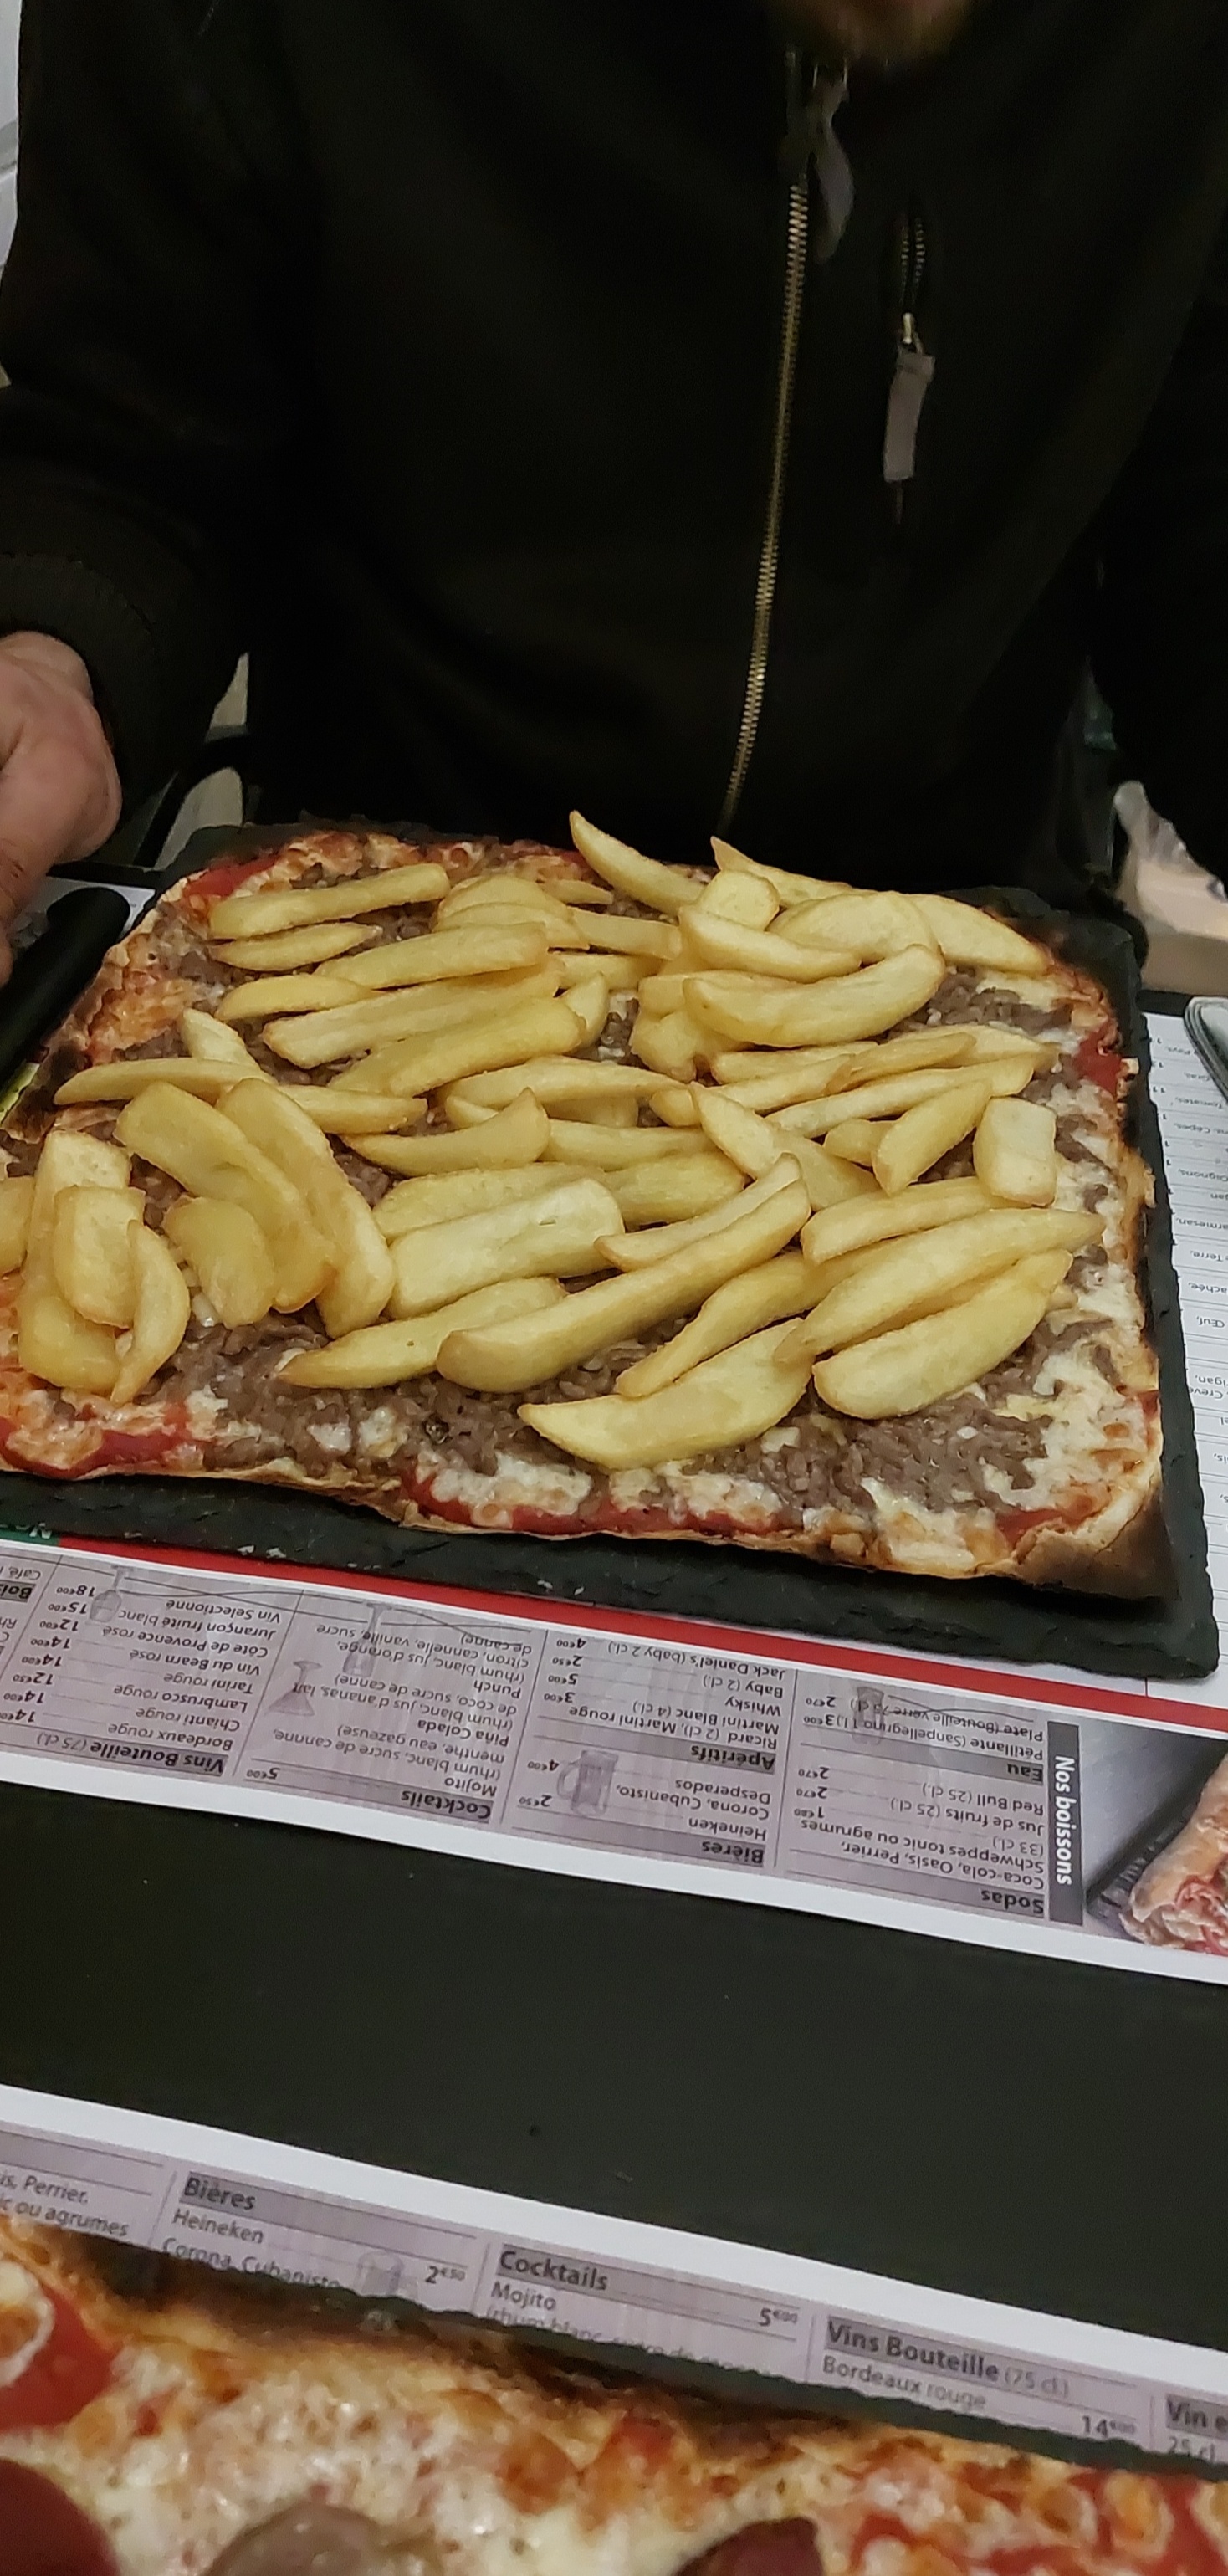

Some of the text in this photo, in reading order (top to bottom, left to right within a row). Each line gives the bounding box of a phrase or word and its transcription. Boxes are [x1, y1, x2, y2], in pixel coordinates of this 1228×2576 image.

[1190, 1251, 1222, 1262] Terre,
[1196, 1316, 1225, 1329] Œuf,
[118, 1608, 159, 1624] blanc
[166, 1600, 254, 1620] Selectionné
[258, 1611, 281, 1624] Vin
[102, 1625, 134, 1640] rosé
[161, 1616, 203, 1632] fruité
[207, 1622, 277, 1641] Jurançon
[316, 1625, 356, 1639] sucre
[137, 1631, 207, 1652] Provence
[211, 1641, 230, 1654] de
[233, 1644, 268, 1658] Côte
[414, 1638, 478, 1658] cannelle,
[513, 1643, 532, 1656] de
[129, 1649, 161, 1663] rosé
[407, 1652, 431, 1667] jus
[484, 1650, 529, 1669] citron,
[632, 1646, 641, 1657] 2
[644, 1646, 685, 1665] (baby
[165, 1654, 209, 1670] Bearn
[212, 1660, 233, 1673] du
[237, 1662, 260, 1676] Vin
[432, 1656, 476, 1677] blanc,
[690, 1655, 749, 1674] Daniel's
[163, 1672, 209, 1687] rouge
[479, 1665, 524, 1684] (rhum
[753, 1664, 786, 1680] Jack
[113, 1683, 159, 1699] rouge
[211, 1678, 253, 1694] Tarini
[473, 1679, 521, 1699] Punch
[727, 1678, 740, 1692] (2
[744, 1679, 783, 1698] Baby
[161, 1692, 248, 1713] Lambrusco
[334, 1673, 517, 1717] de coco, sucre de canne)
[136, 1707, 181, 1723] rouge
[393, 1699, 417, 1714] jus
[418, 1703, 463, 1724] blanc,
[569, 1705, 615, 1723] rouge
[657, 1705, 672, 1719] (4
[724, 1697, 781, 1717] Whisky
[184, 1713, 240, 1732] Chianti
[468, 1712, 514, 1731] (rhum
[619, 1713, 676, 1733] Martini
[675, 1708, 718, 1725] Blanc
[722, 1716, 779, 1734] Martini
[933, 1713, 999, 1734] (Bouteille
[0, 1709, 233, 1751] Bordeaux rouge 14€0
[417, 1718, 472, 1740] Colada
[705, 1728, 719, 1744] (2
[1004, 1725, 1043, 1742] Plate
[62, 1737, 86, 1752] (75
[335, 1741, 356, 1755] de
[337, 1724, 505, 1764] menthe, eau gazeuse)
[728, 1732, 777, 1749] Ricard
[970, 1739, 1043, 1760] Pétillante
[89, 1741, 178, 1767] Bouteille
[359, 1745, 401, 1761] sucre
[404, 1751, 450, 1773] blanc,
[690, 1745, 775, 1771] Apéritifs
[184, 1754, 223, 1774] Vins
[453, 1761, 501, 1780] (rhum
[798, 1766, 829, 1780] 2€70
[1007, 1764, 1043, 1781] Eau
[443, 1776, 498, 1797] Mojito
[675, 1779, 771, 1805] Desperados
[796, 1786, 827, 1799] 2€70
[401, 1790, 491, 1820] Cocktails
[615, 1785, 770, 1821] Corona, Cubanisto,
[949, 1789, 972, 1804] (25
[976, 1793, 1008, 1810] Bull
[917, 1803, 940, 1818] (25
[945, 1807, 988, 1827] fruits
[1013, 1799, 1044, 1816] Red
[688, 1818, 766, 1841] Heineken
[993, 1817, 1013, 1831] de
[1018, 1821, 1045, 1836] Jus
[1055, 1755, 1077, 1885] Nos boissons
[701, 1841, 765, 1865] Bières
[801, 1819, 1044, 1874] Schweppes tonic ou agrumes
[1019, 1841, 1043, 1857] (33
[841, 1841, 1044, 1890] Coca-cola, Oasis, Perrier,
[980, 1890, 1044, 1914] Sodas
[184, 2177, 256, 2210] Bières
[16, 2201, 42, 2218] ou
[45, 2207, 130, 2236] agrumes
[171, 2208, 264, 2244] Heineken
[501, 2251, 608, 2290] Cocktails
[491, 2282, 556, 2310] Mojito
[828, 2321, 879, 2352] Vins
[886, 2336, 999, 2381] Bouteille
[823, 2354, 922, 2393] Bordeaux
[927, 2385, 985, 2410] rouge
[1167, 2399, 1208, 2428] Vin
